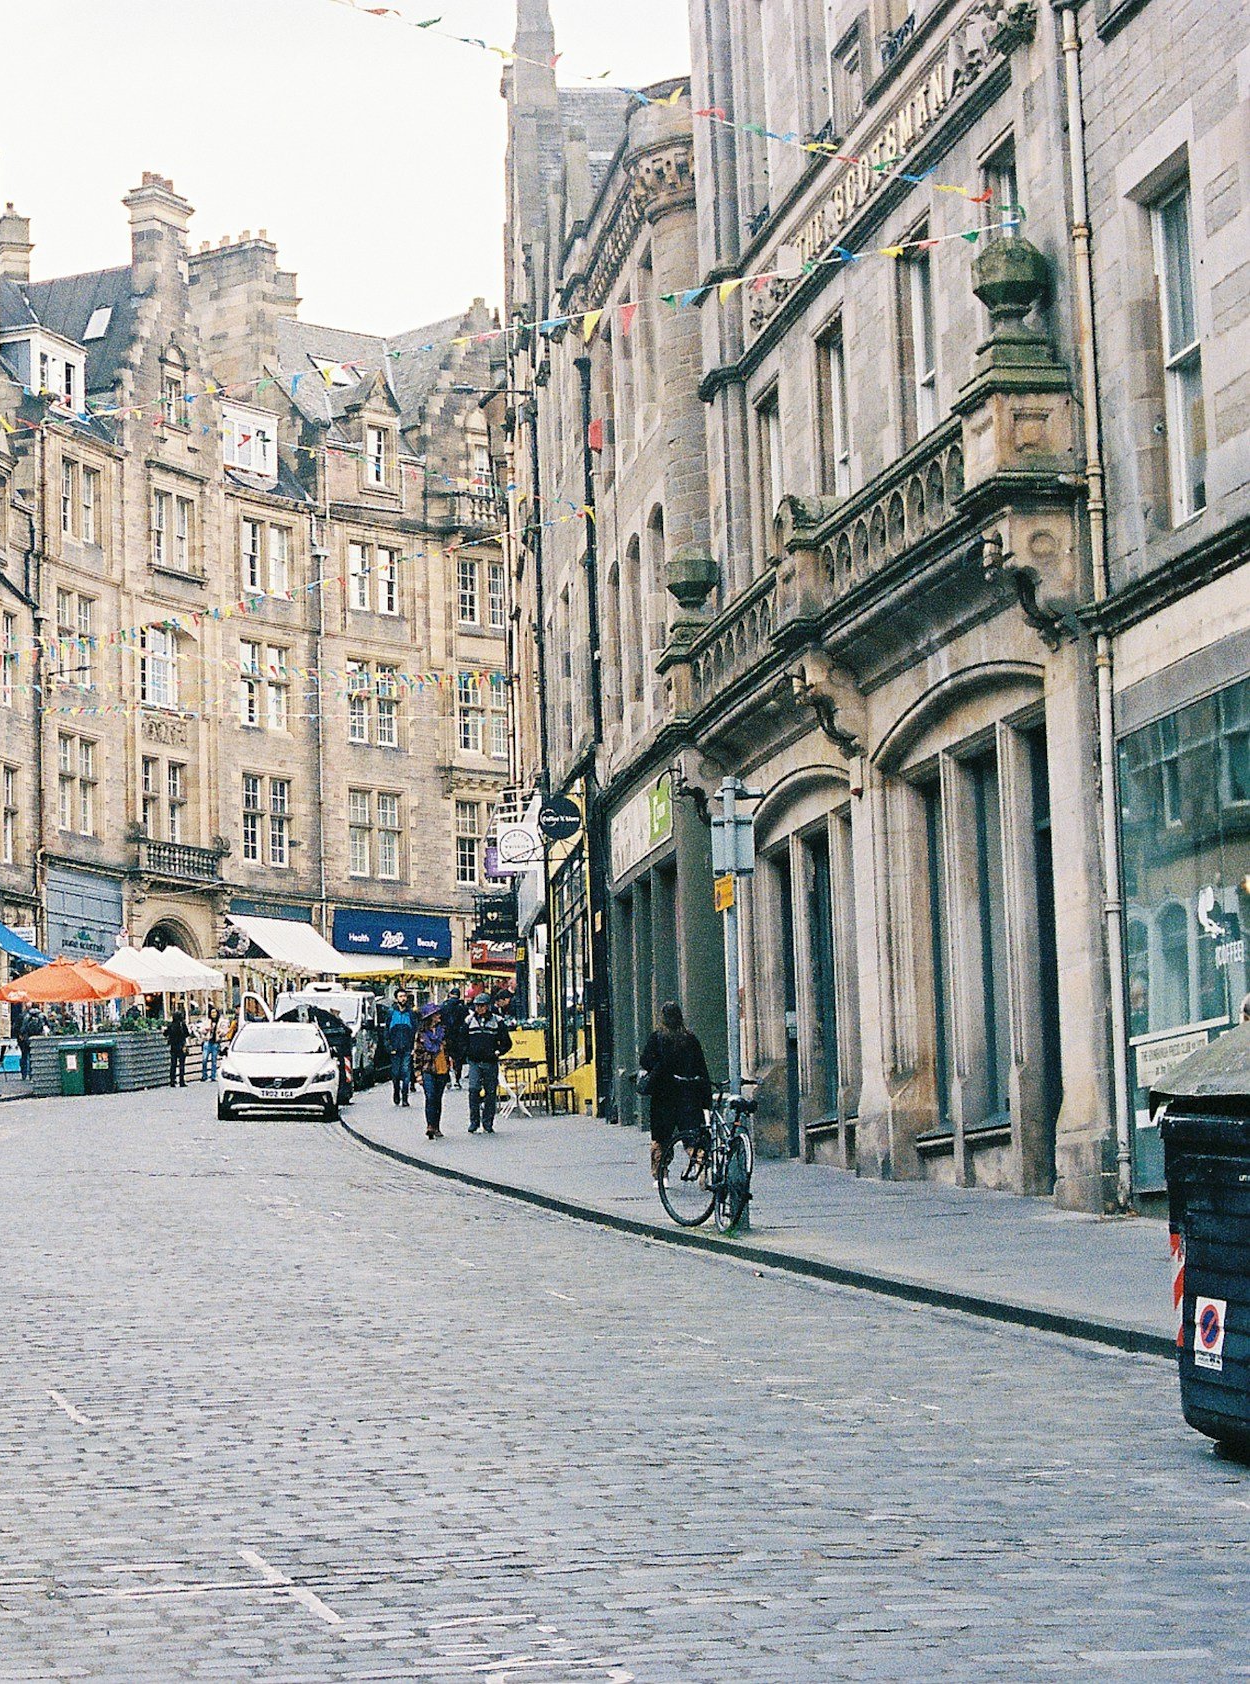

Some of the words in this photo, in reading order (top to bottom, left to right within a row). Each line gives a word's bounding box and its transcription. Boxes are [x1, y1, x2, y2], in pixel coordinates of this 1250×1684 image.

[796, 211, 825, 261] THE
[833, 63, 945, 222] SCOTSMAN
[348, 932, 370, 943] Health
[416, 937, 439, 950] Beauty
